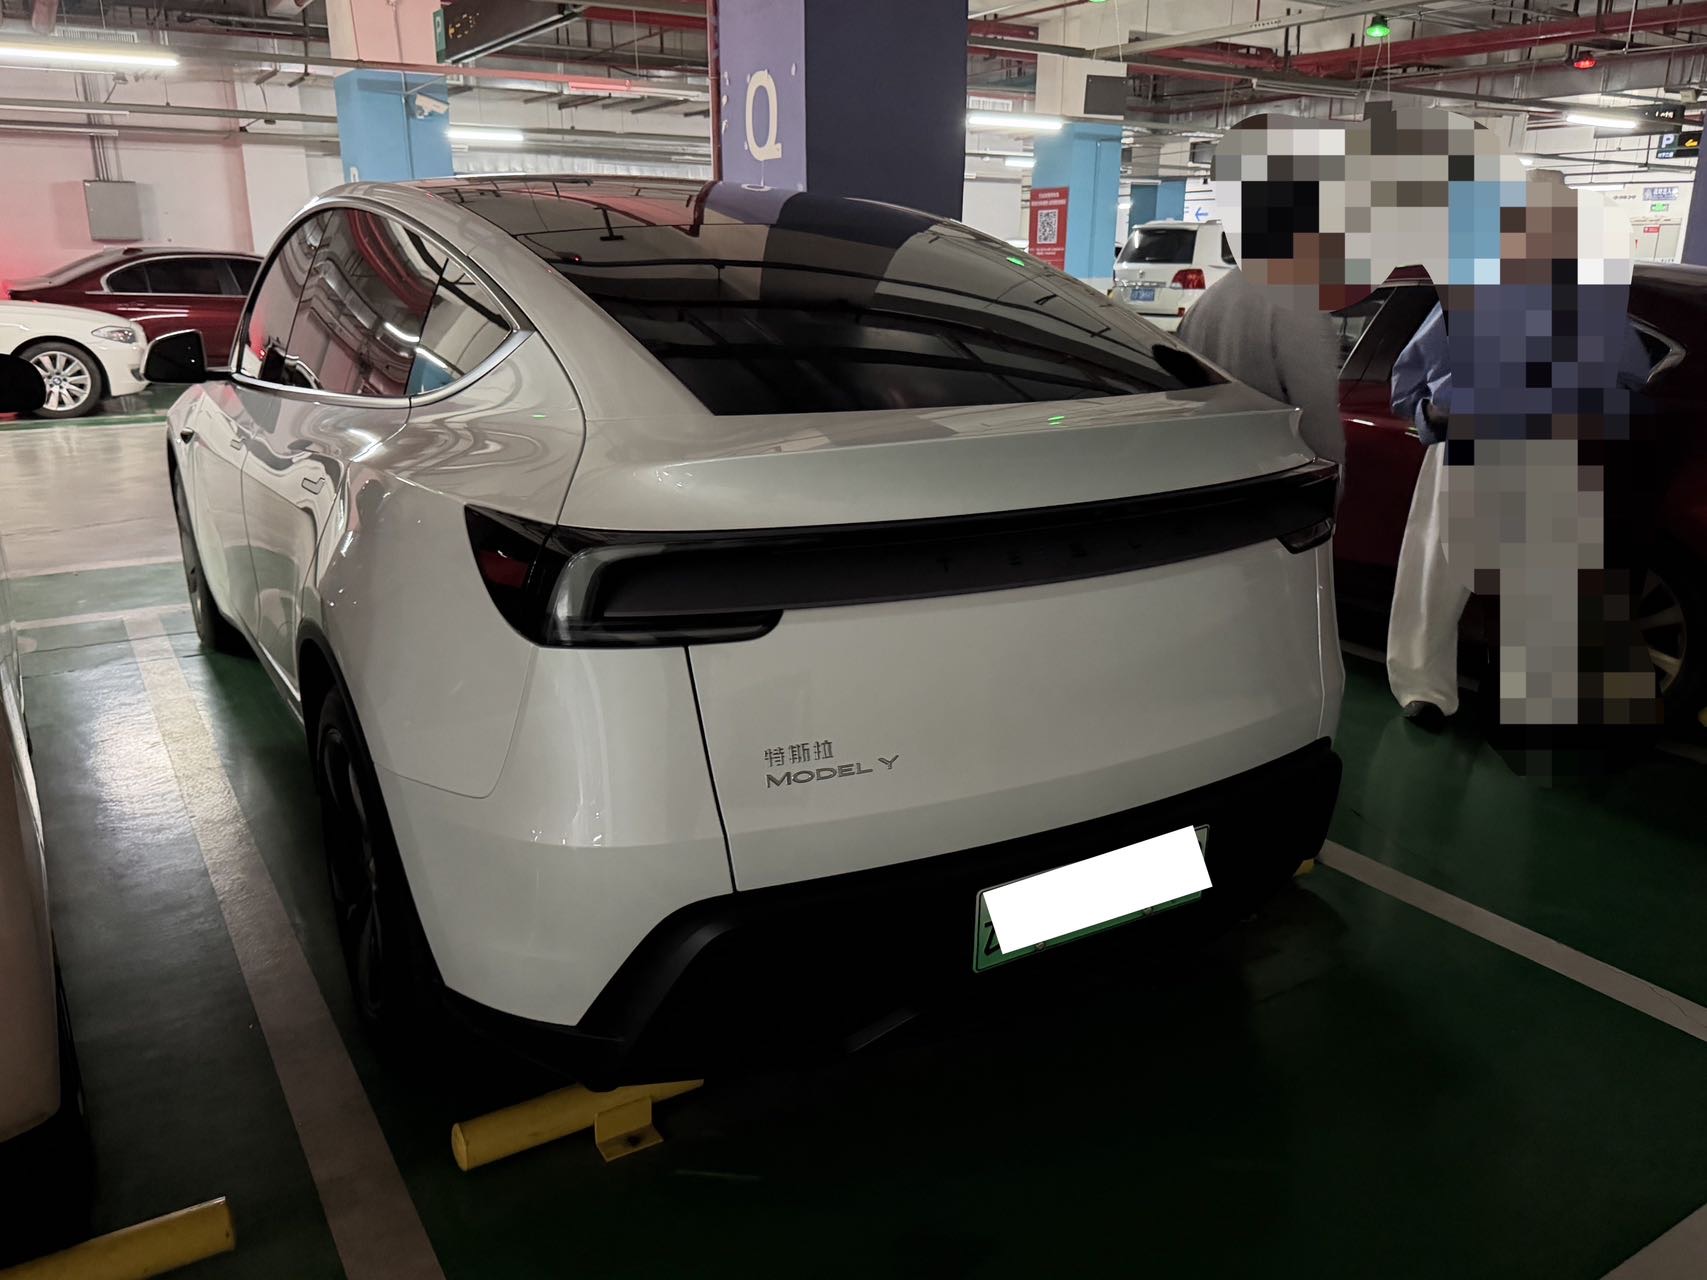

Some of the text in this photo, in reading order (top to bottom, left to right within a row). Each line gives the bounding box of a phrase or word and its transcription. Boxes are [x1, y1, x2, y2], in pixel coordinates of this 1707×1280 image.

[745, 69, 782, 161] Q
[1661, 133, 1675, 148] P
[764, 740, 834, 767] 特斯拉
[766, 755, 899, 788] MODEL Y
